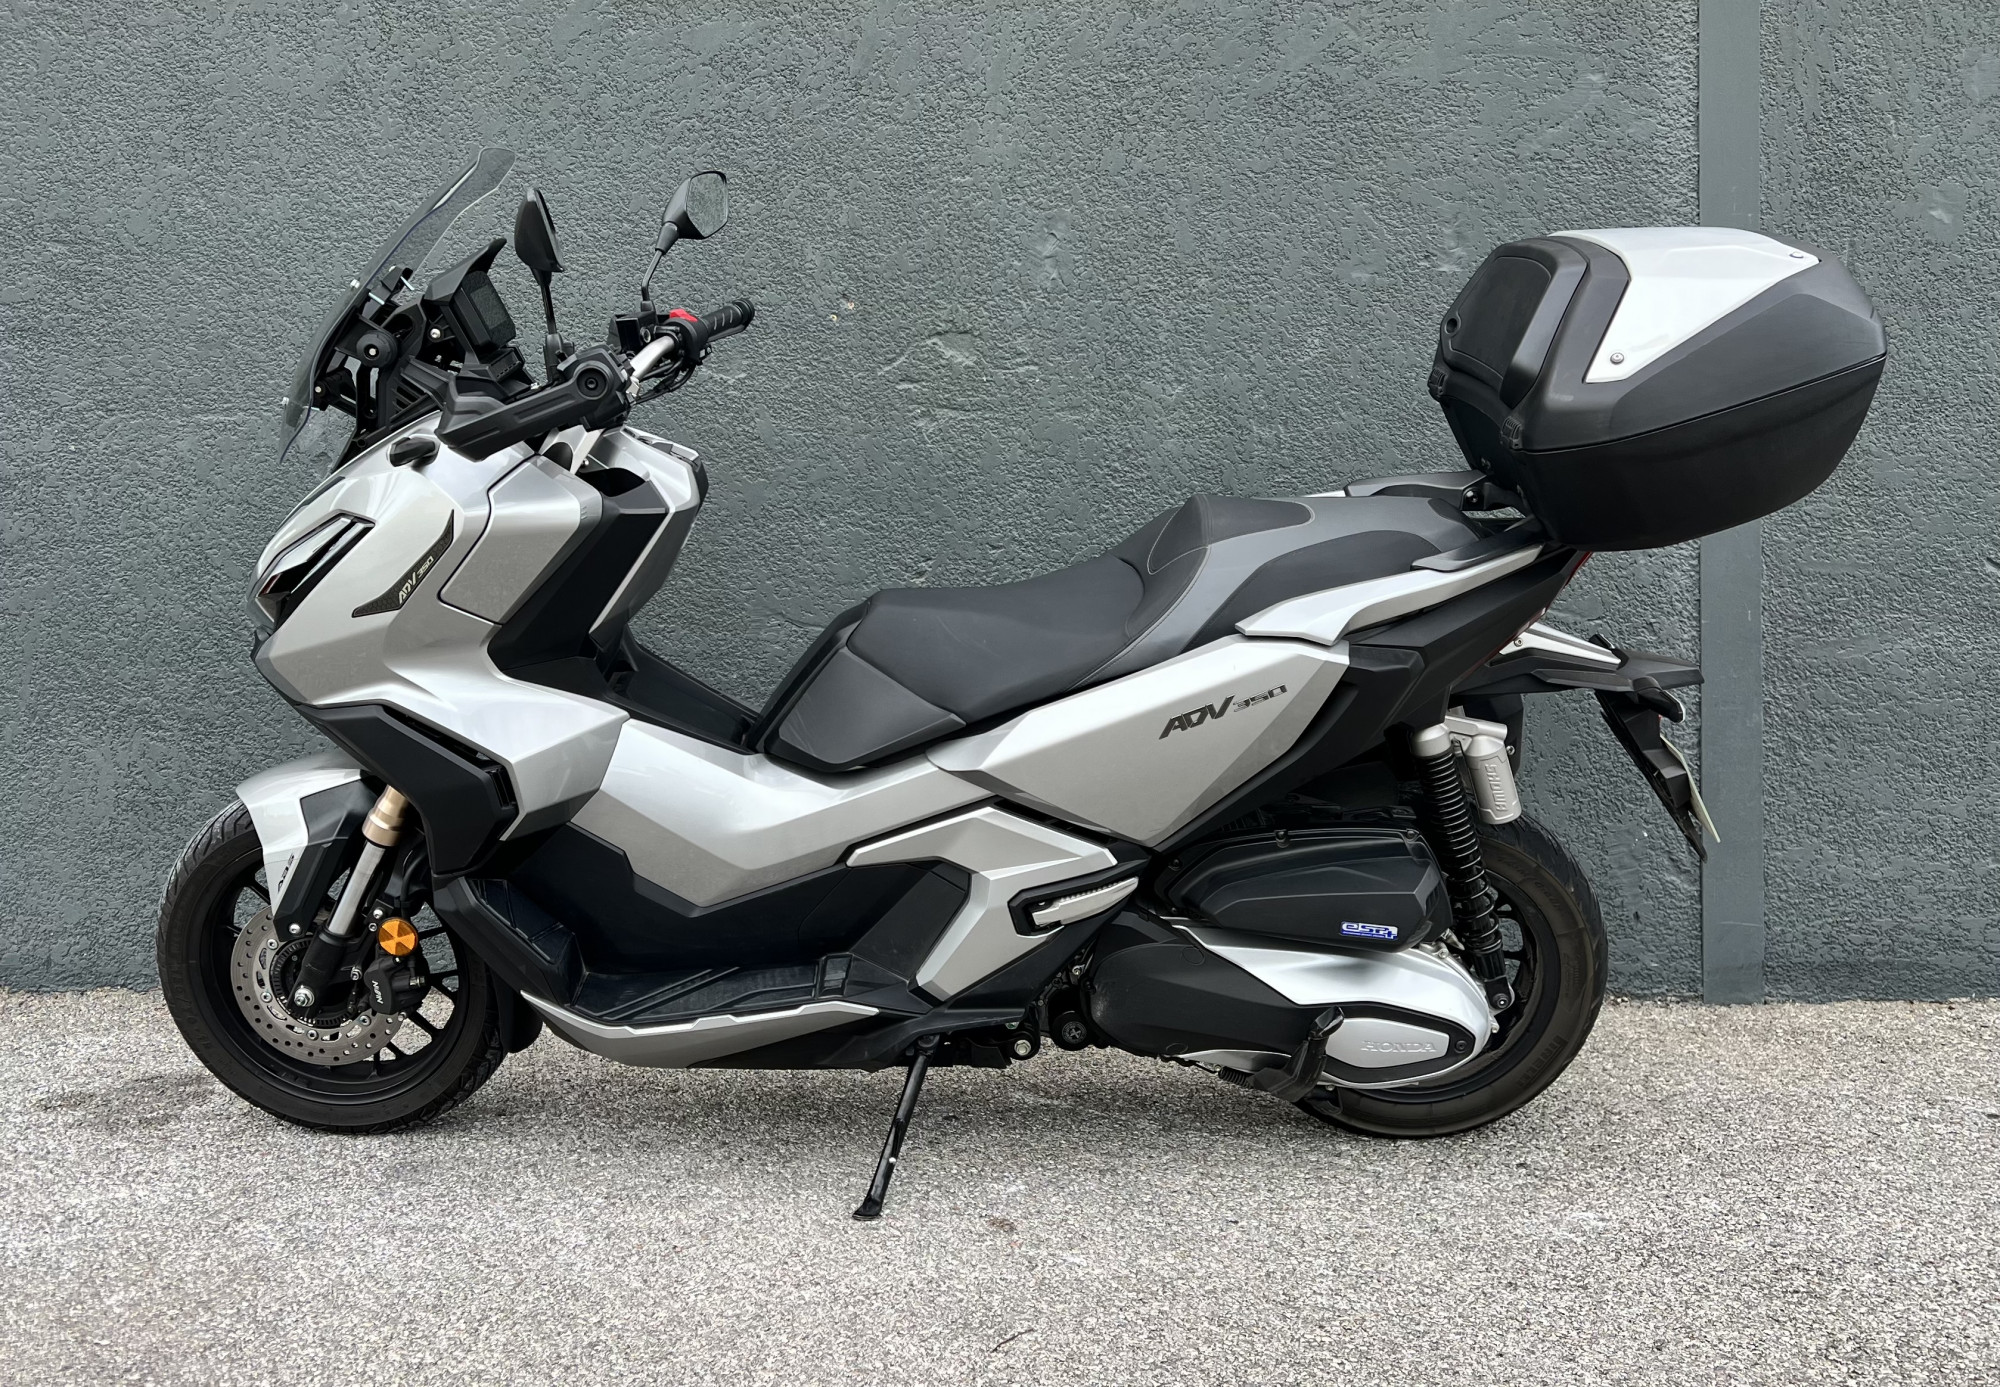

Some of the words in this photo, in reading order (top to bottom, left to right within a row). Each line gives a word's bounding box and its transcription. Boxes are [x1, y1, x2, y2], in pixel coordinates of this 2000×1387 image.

[398, 571, 417, 604] ADV
[416, 555, 434, 578] 350
[1158, 694, 1235, 740] ADV
[1233, 684, 1288, 713] 350
[1484, 763, 1508, 812] SHOWA
[1360, 1040, 1438, 1053] HONDA
